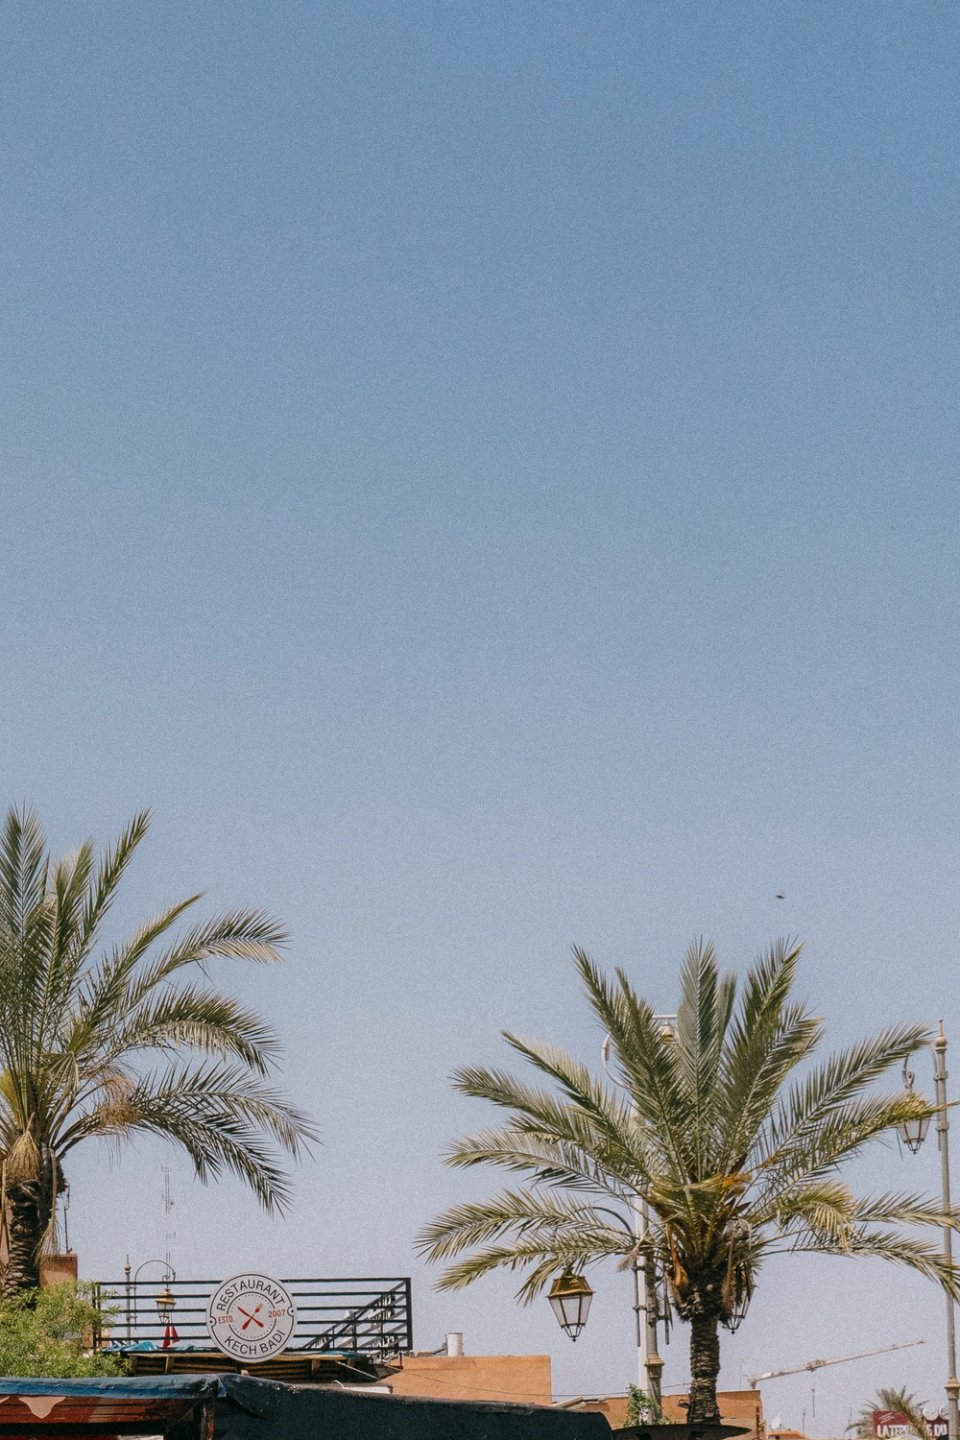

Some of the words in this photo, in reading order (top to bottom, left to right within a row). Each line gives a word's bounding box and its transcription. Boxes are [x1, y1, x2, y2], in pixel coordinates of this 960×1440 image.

[216, 1279, 285, 1311] RESTAURANT
[268, 1309, 286, 1318] 2007
[224, 1335, 257, 1355] KECH
[259, 1329, 286, 1353] BADI
